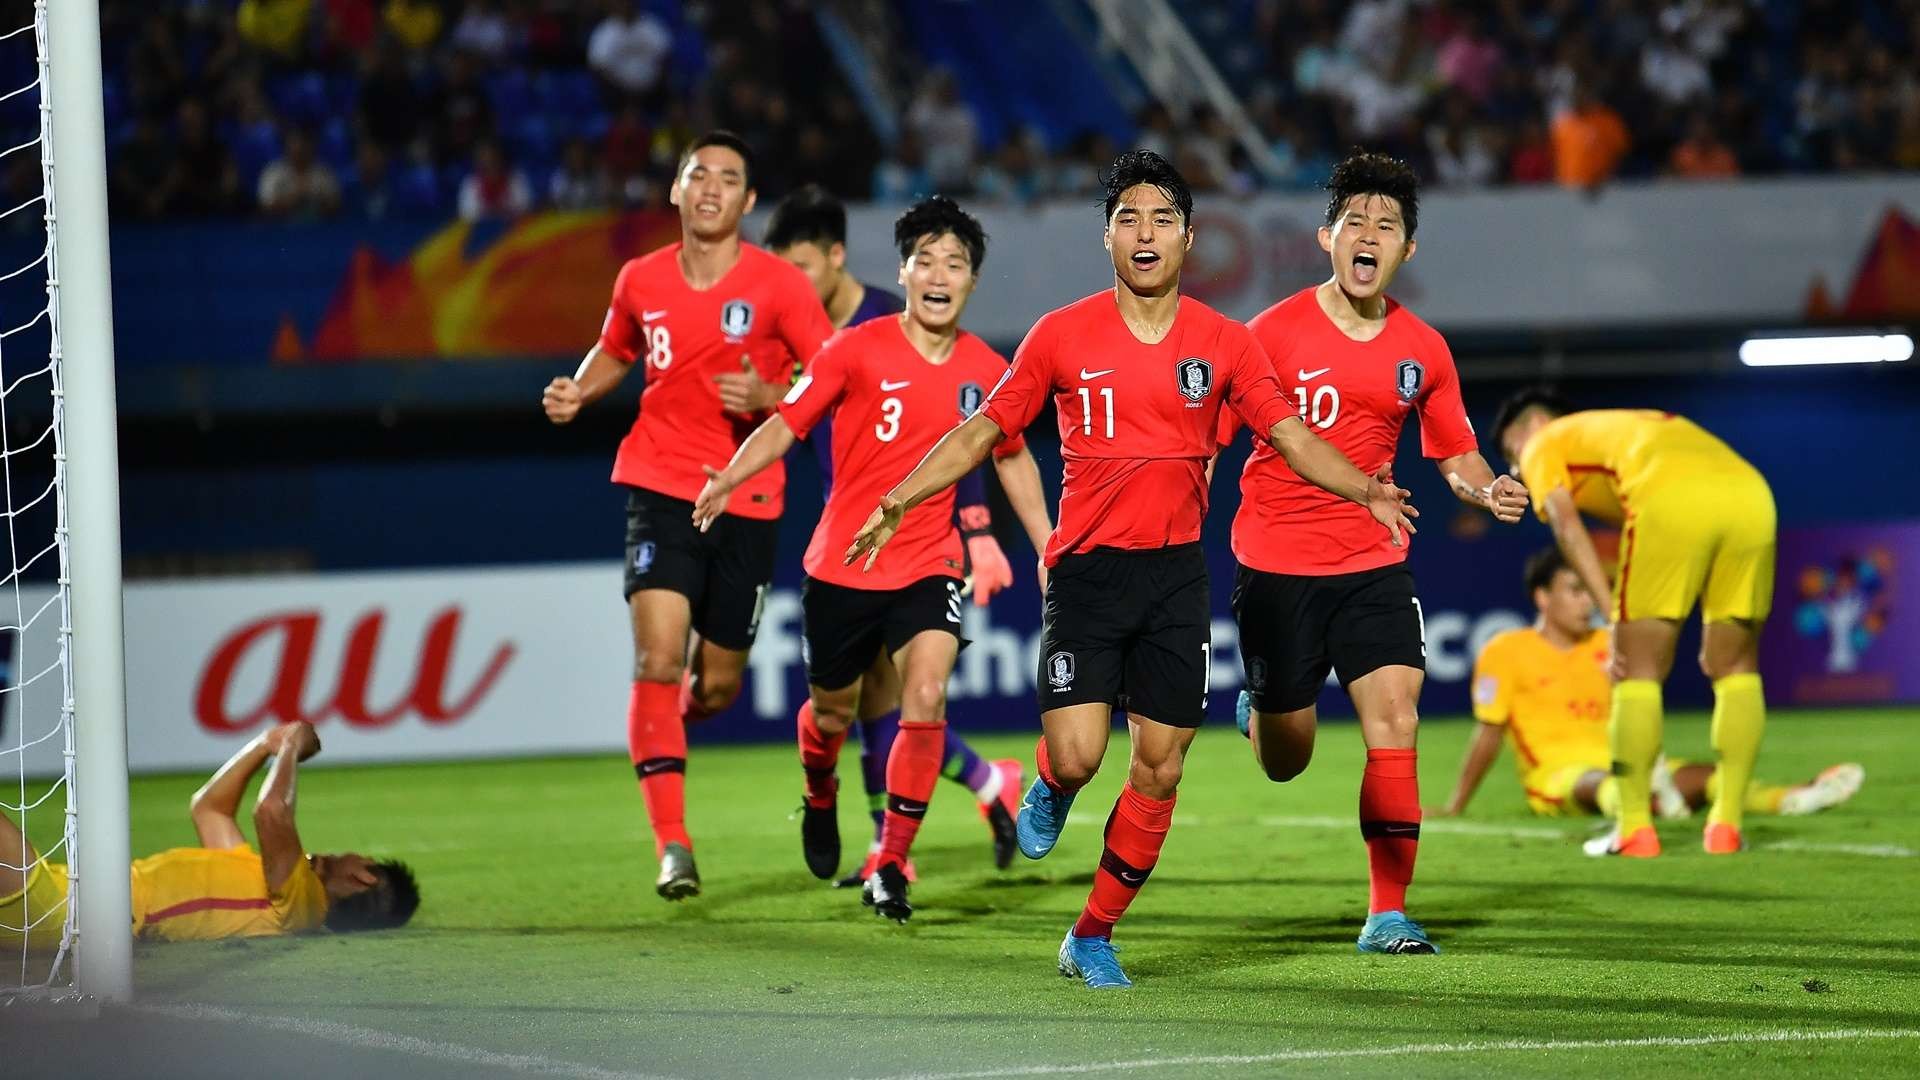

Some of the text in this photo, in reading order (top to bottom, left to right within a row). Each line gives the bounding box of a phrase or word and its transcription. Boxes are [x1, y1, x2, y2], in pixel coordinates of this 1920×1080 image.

[875, 397, 903, 442] 3
[1077, 387, 1114, 438] 11
[1294, 385, 1340, 429] 10
[193, 604, 517, 734] au
